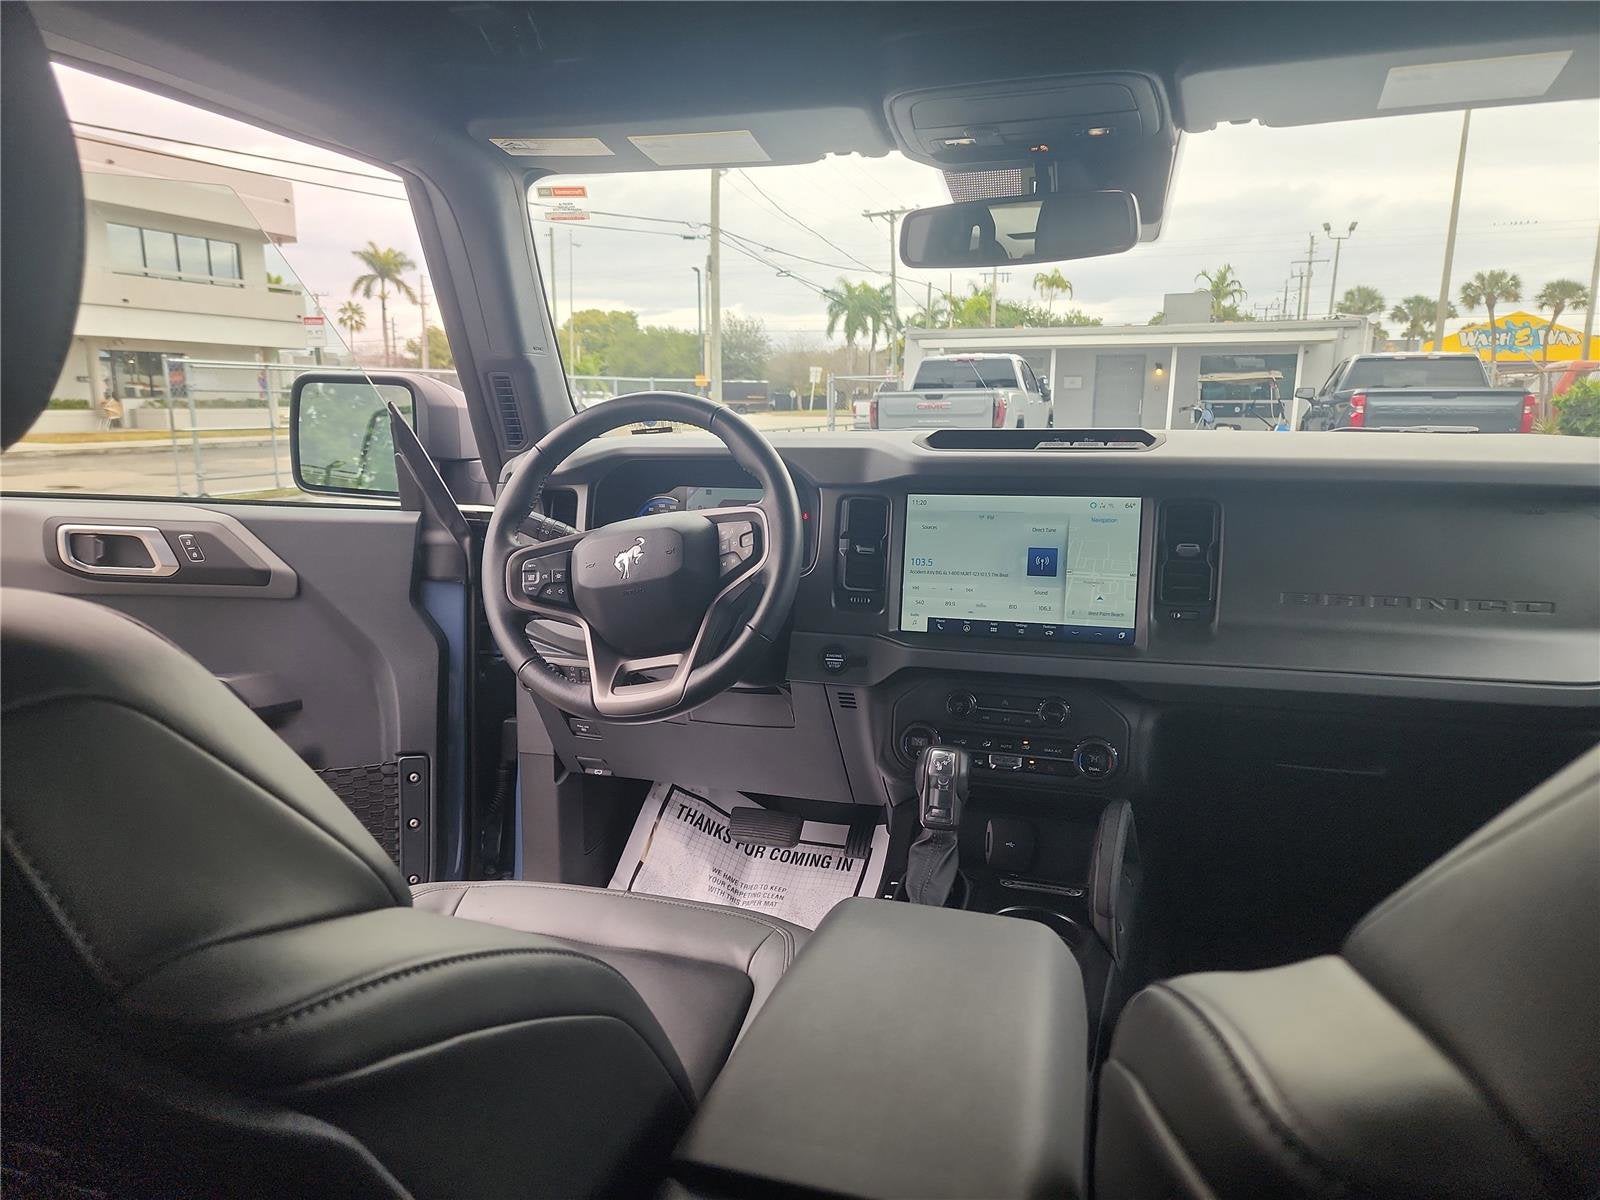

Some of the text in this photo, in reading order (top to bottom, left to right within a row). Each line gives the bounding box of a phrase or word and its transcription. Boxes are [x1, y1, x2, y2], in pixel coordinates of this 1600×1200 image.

[911, 557, 933, 567] 103.5
[1280, 592, 1556, 614] BRONCO
[676, 803, 732, 844] THANKS
[769, 847, 832, 869] COMING
[835, 857, 855, 872] IN
[708, 874, 785, 901] YOUR CARPETING CLEAN
[712, 866, 722, 876] WE
[723, 872, 740, 887] HAVE
[740, 881, 759, 891] TRIED
[708, 884, 779, 908] WITH THIS PAPER MAT
